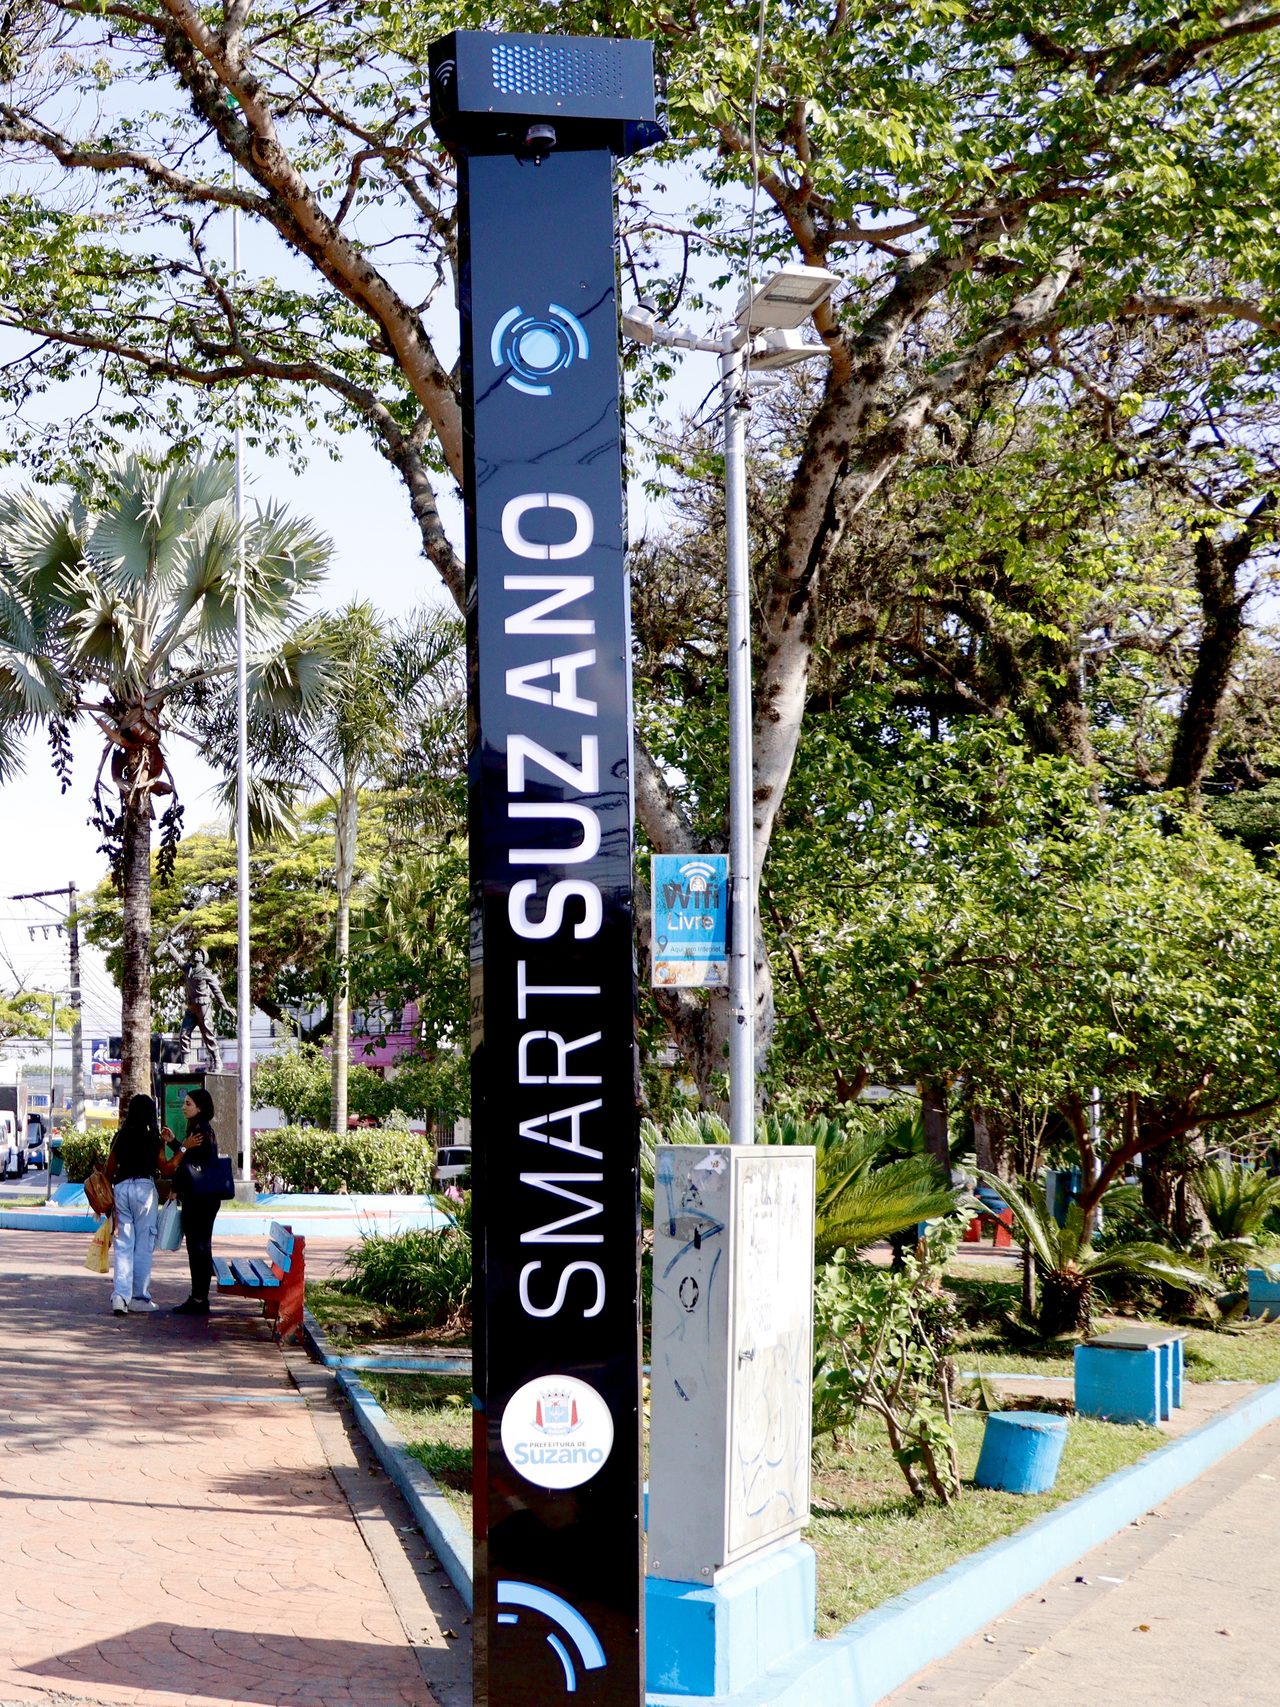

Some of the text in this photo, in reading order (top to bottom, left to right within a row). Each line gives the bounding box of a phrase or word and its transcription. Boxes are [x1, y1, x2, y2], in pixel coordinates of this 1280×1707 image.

[501, 491, 606, 1318] SMART SUZANO
[667, 912, 714, 930] Livre
[514, 1442, 604, 1465] Suzano
